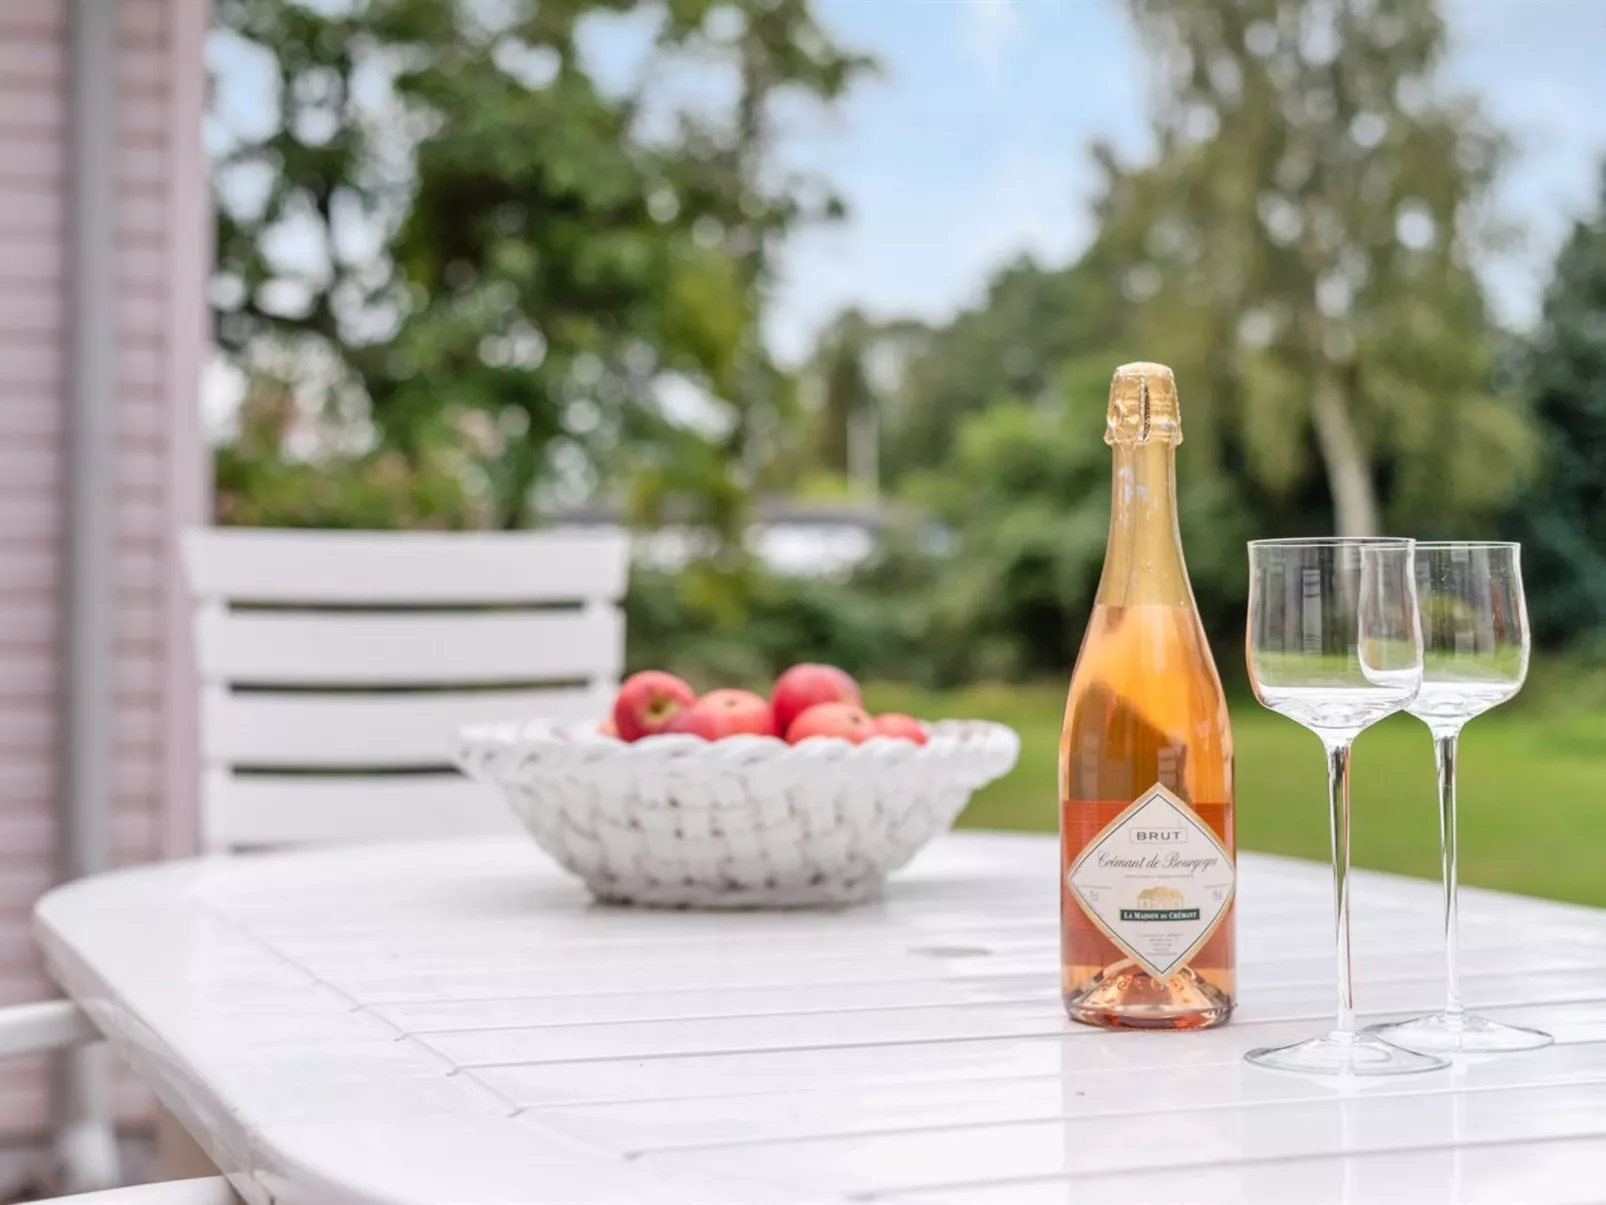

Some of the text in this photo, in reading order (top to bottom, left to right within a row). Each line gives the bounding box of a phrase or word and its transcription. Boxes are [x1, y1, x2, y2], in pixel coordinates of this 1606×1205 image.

[1136, 831, 1182, 841] BRUT
[1097, 850, 1146, 869] Crémant
[1146, 852, 1159, 868] de
